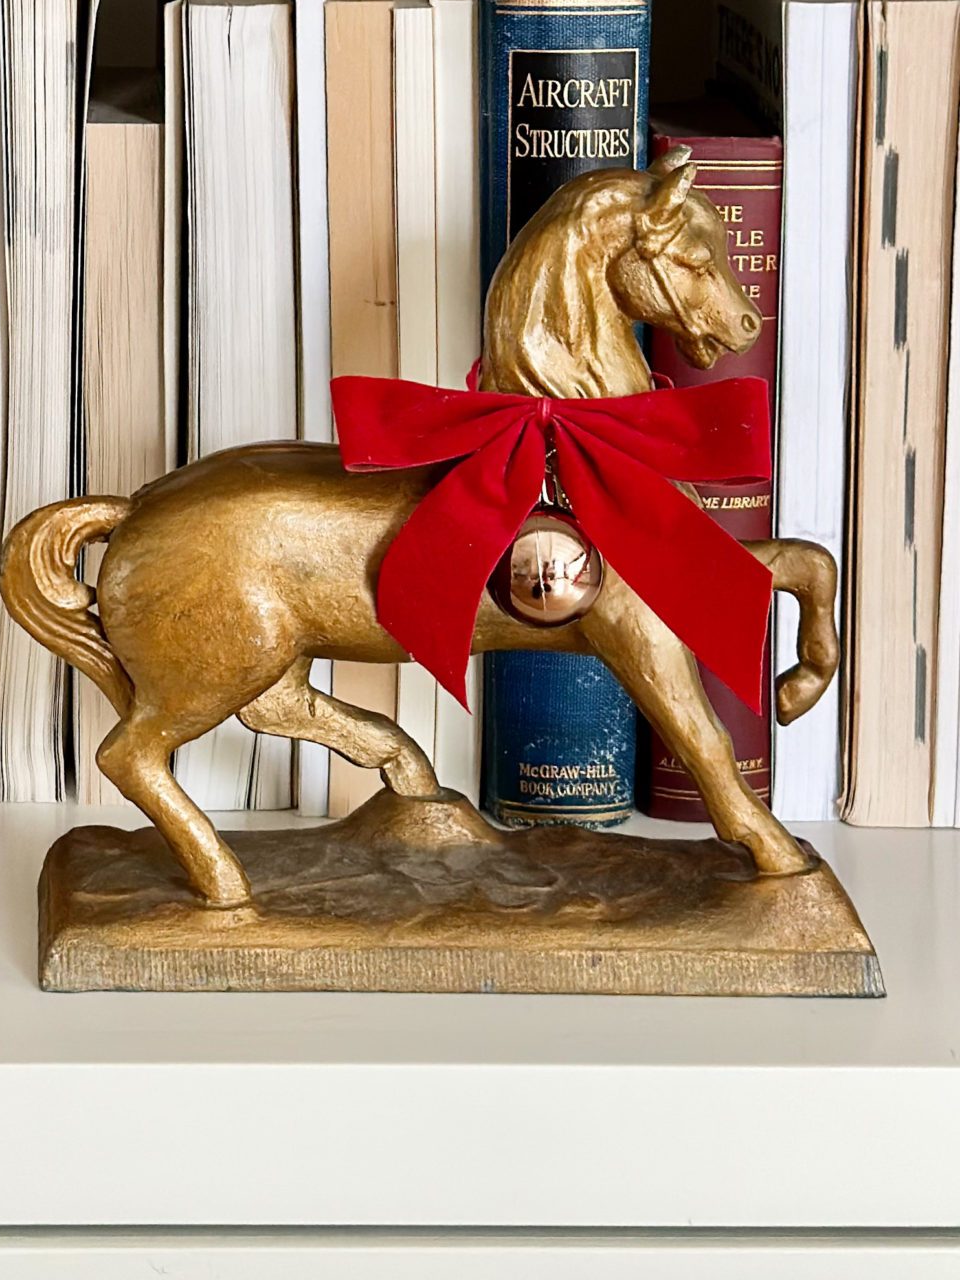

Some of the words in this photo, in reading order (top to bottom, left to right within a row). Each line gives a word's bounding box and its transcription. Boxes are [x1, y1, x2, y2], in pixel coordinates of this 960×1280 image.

[517, 72, 632, 108] AIRCRAFT
[515, 123, 630, 158] STRUCTURES
[721, 494, 770, 509] LIBRARY
[519, 762, 616, 779] McGRAW-HILL
[520, 780, 553, 796] BOOK
[557, 780, 619, 796] COMPANY
